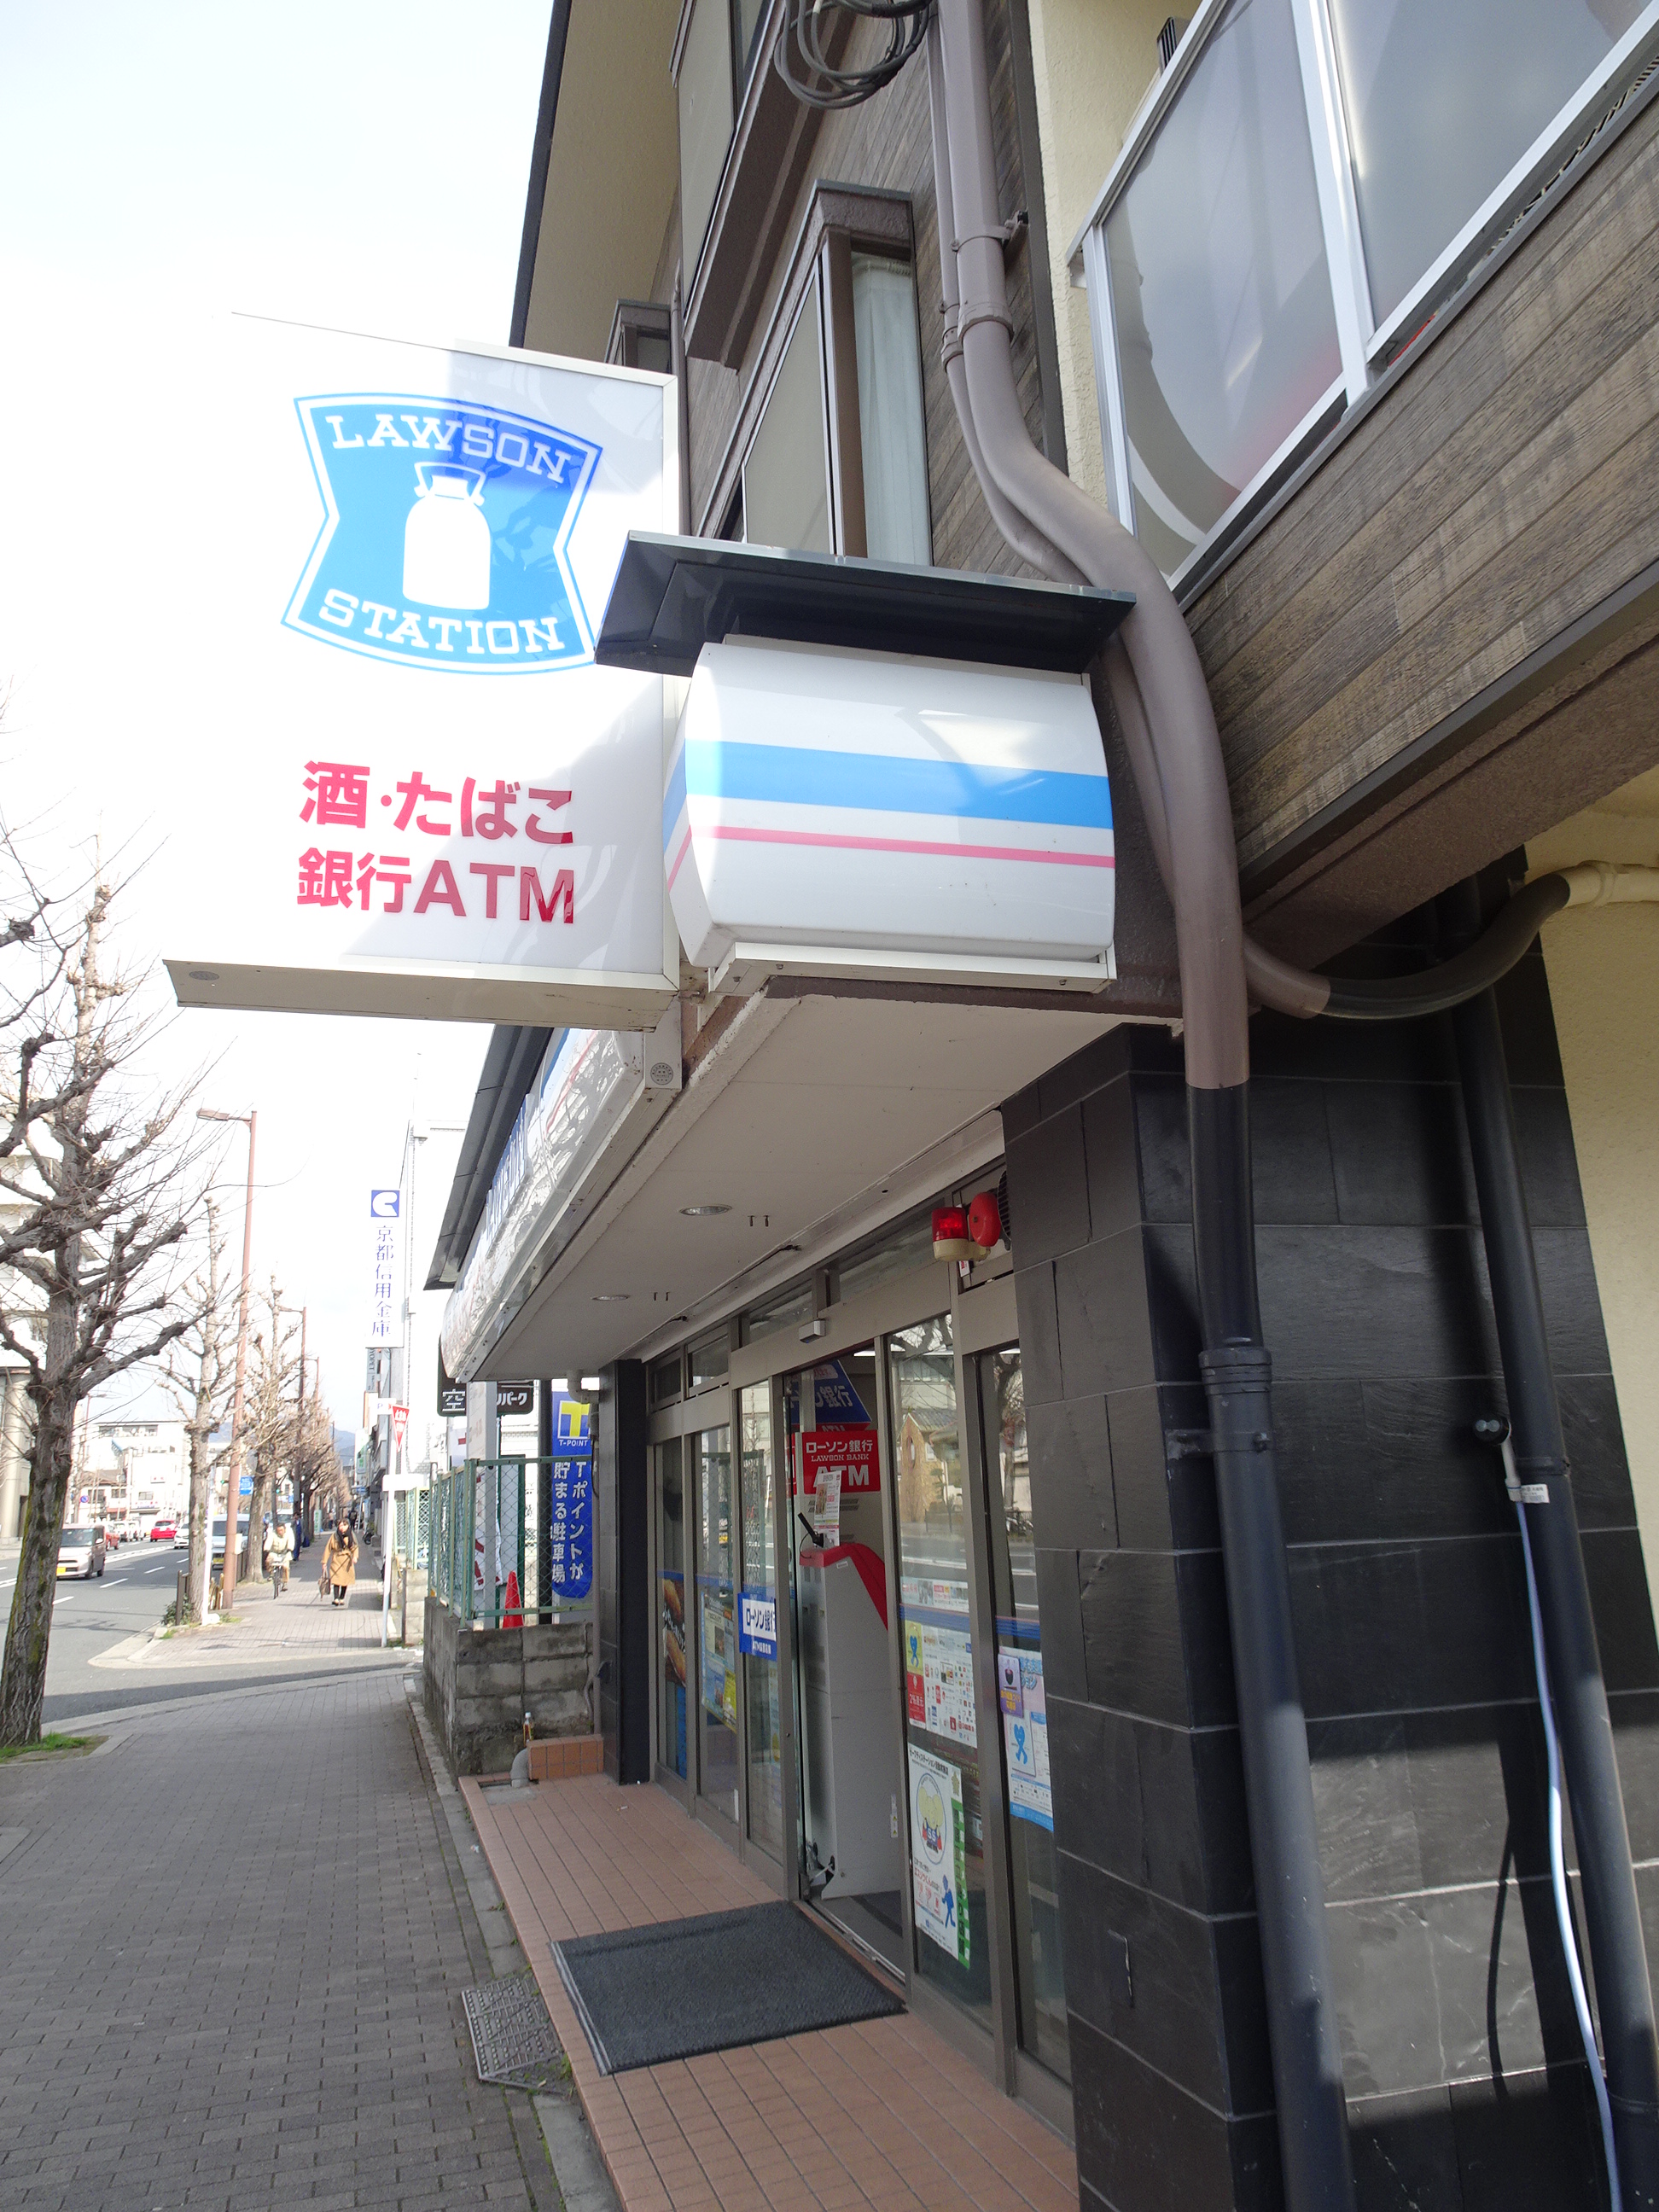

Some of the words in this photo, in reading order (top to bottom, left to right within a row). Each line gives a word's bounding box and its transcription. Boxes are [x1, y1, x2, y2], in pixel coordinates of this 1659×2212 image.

[325, 414, 572, 484] LAWSON
[318, 588, 566, 655] STATION
[299, 760, 574, 845] 酒・たばこ
[297, 847, 574, 924] 銀行ATM
[372, 1225, 393, 1337] 京都信用金庫
[442, 1388, 466, 1412] 空
[806, 1439, 873, 1453] ローソン銀行
[550, 1462, 571, 1584] 貯まる駐車場
[570, 1462, 588, 1580] Tポイントが
